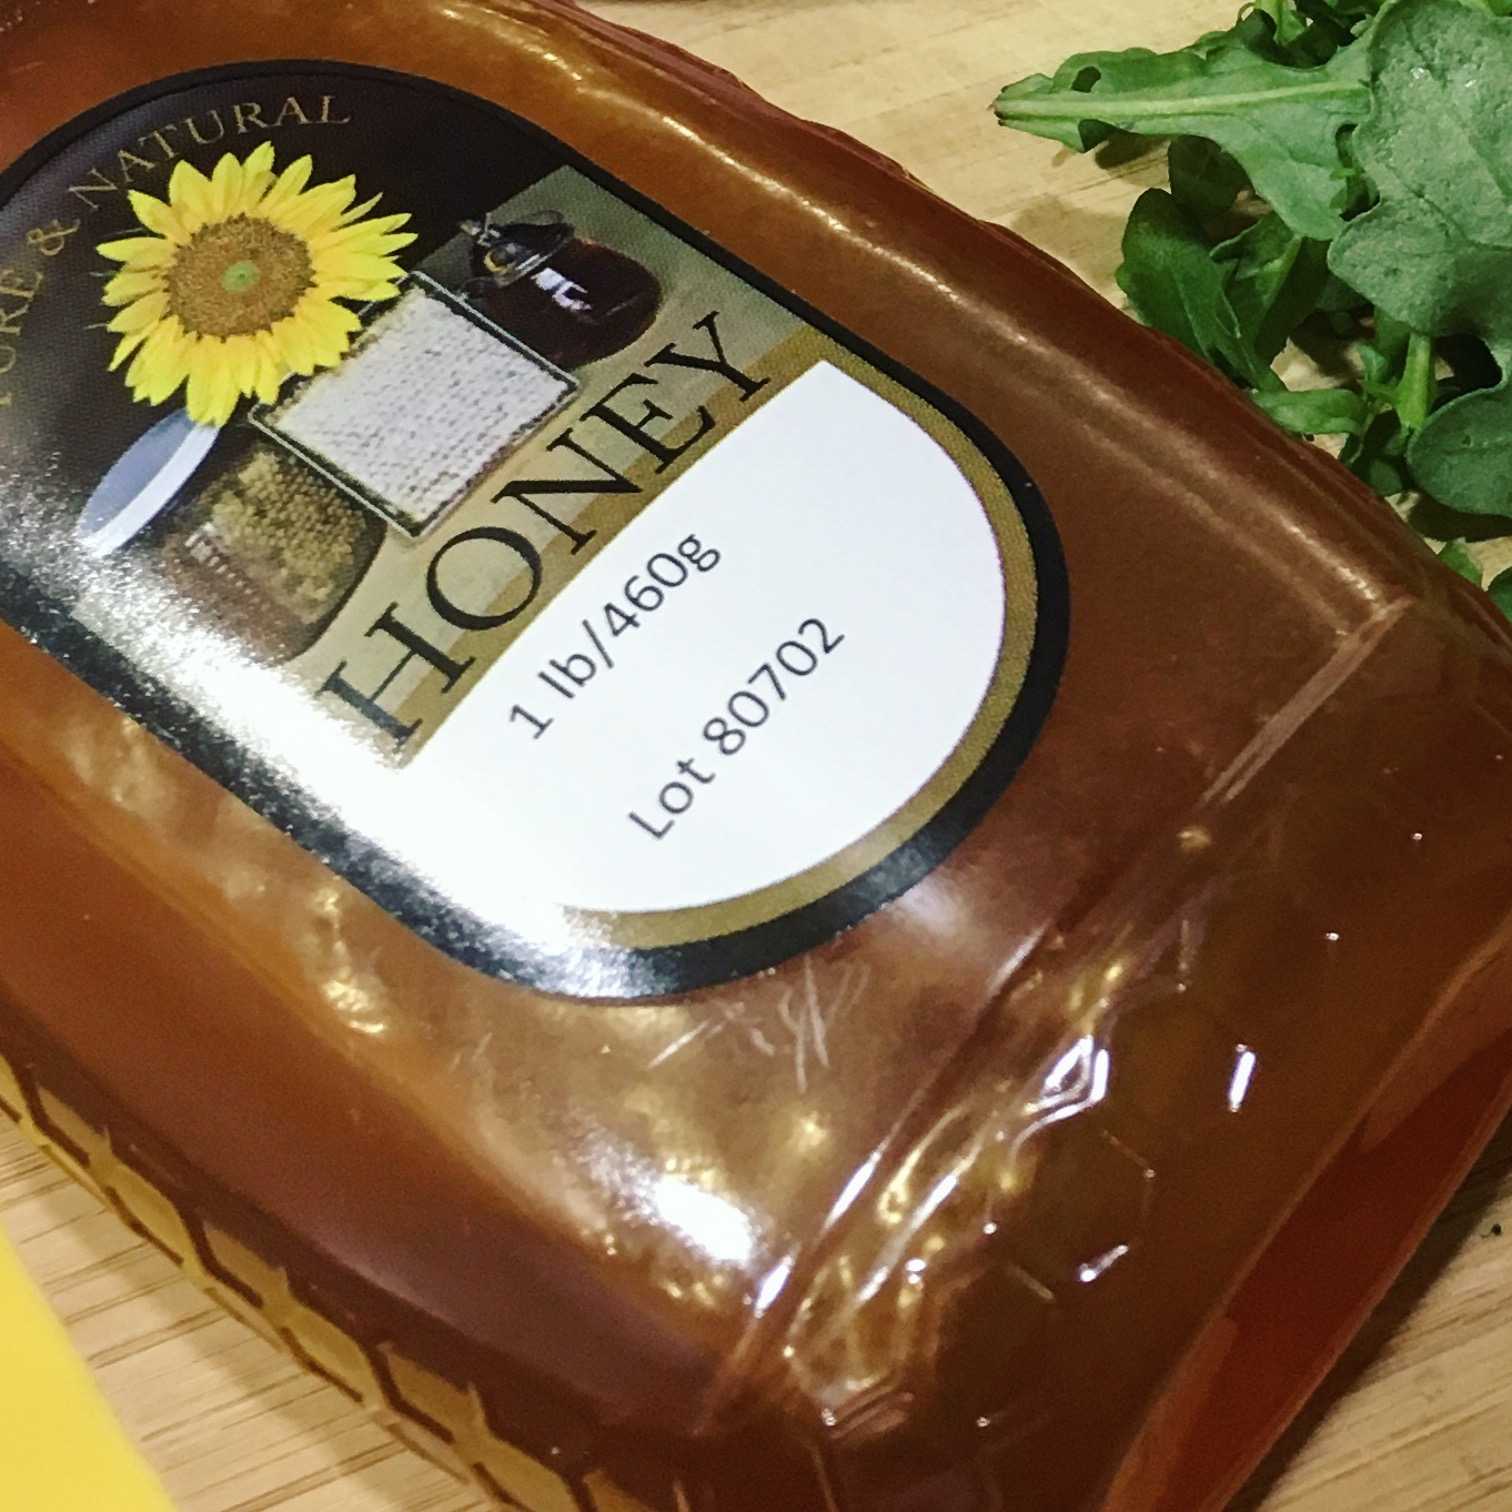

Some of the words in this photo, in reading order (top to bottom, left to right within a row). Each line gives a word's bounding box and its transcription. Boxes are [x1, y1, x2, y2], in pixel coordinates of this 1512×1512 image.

[0, 269, 44, 406] RE
[26, 219, 81, 256] &
[69, 95, 350, 210] NATURAL
[316, 311, 770, 753] HONEY
[509, 704, 553, 739] 1
[538, 534, 721, 698] lb/460g
[628, 757, 716, 840] Lot
[702, 617, 845, 756] 80702
